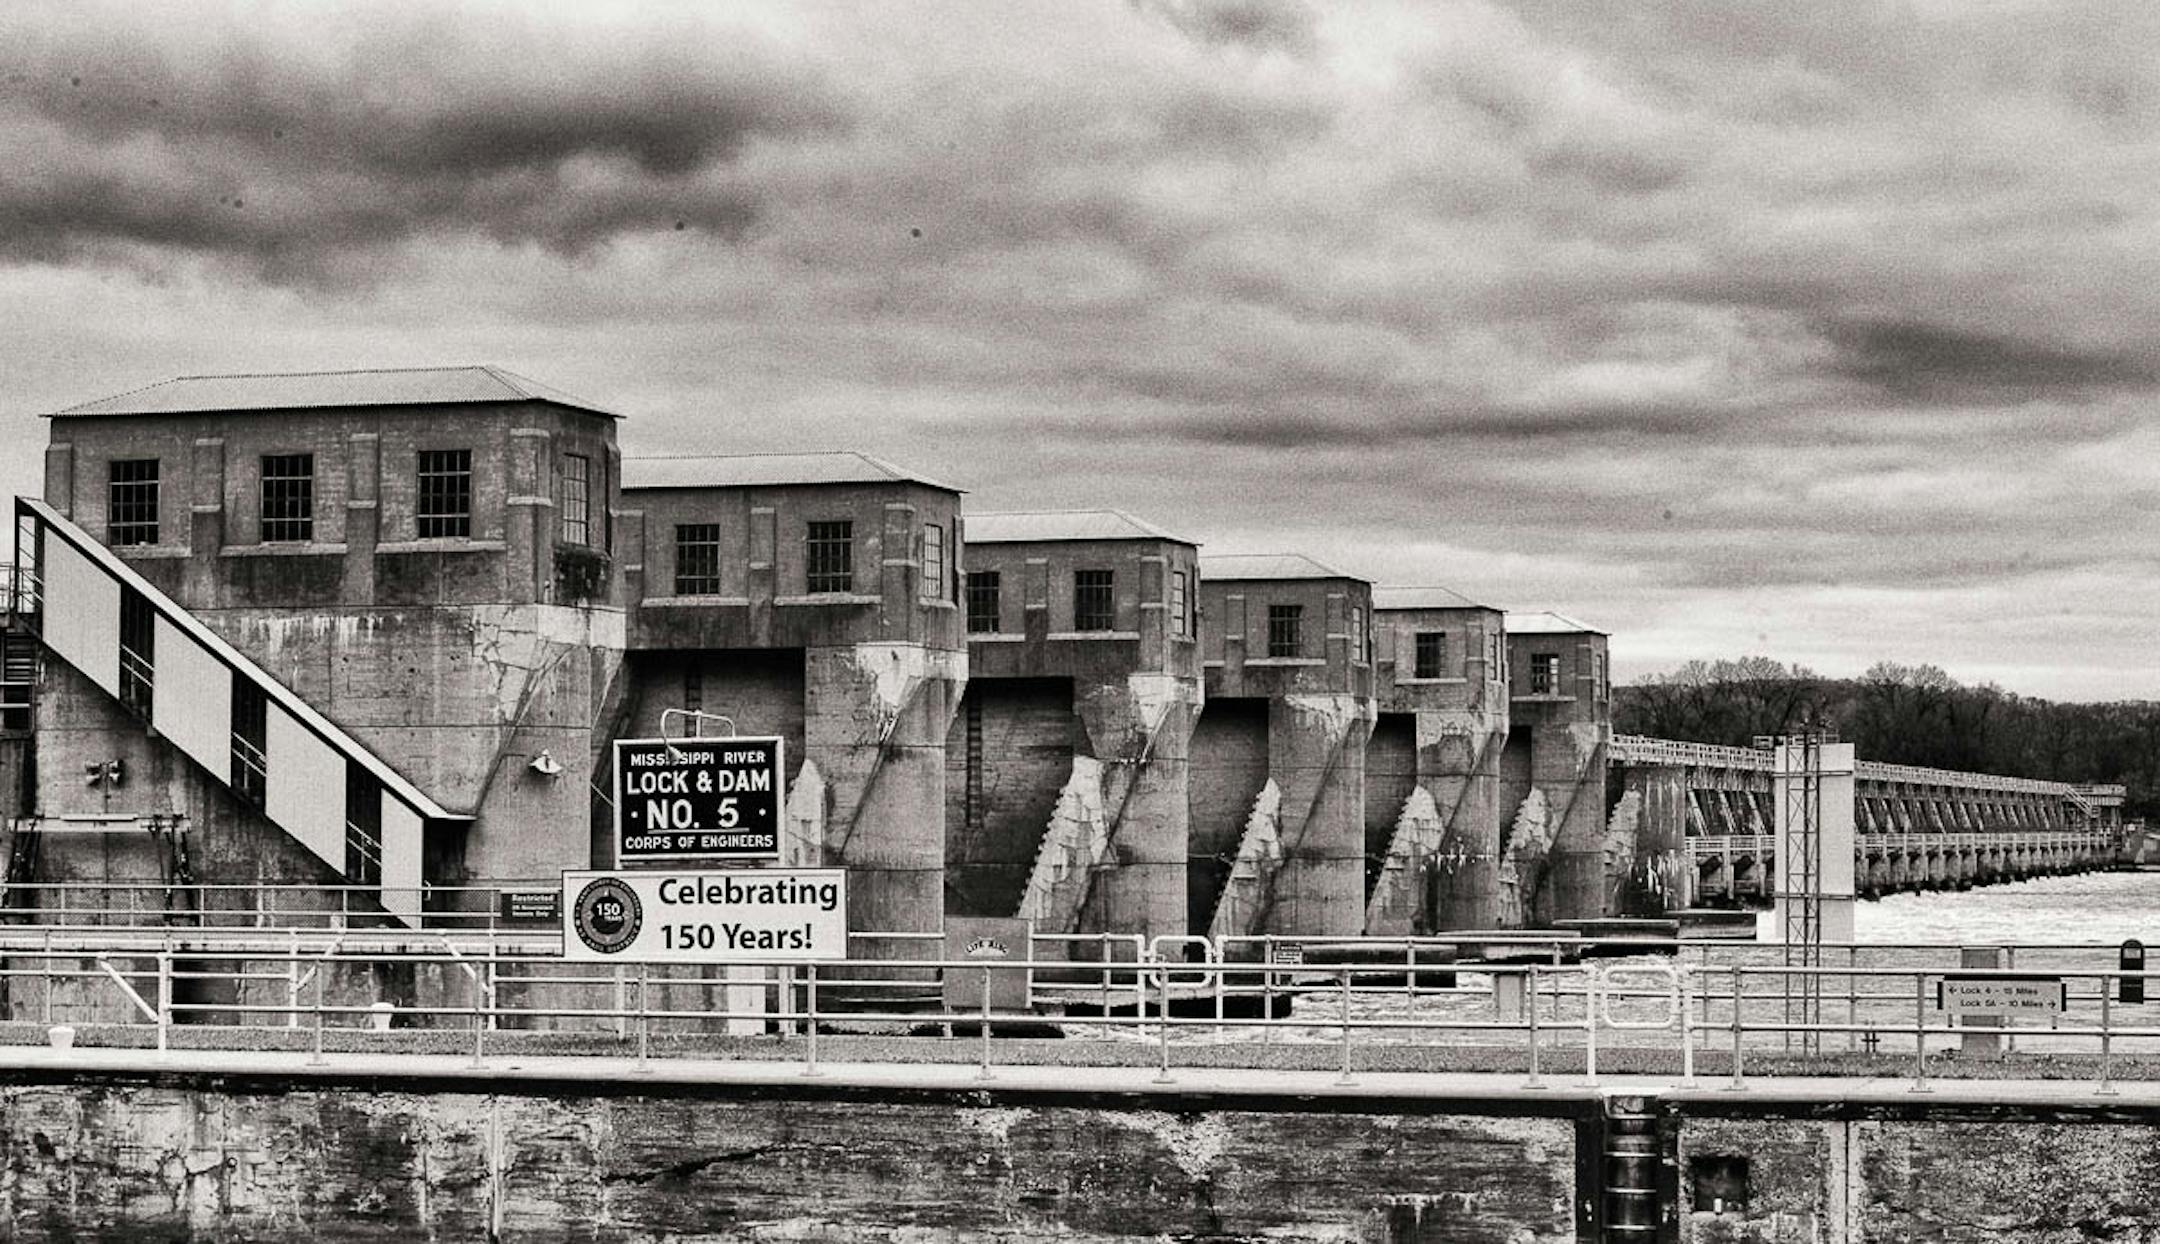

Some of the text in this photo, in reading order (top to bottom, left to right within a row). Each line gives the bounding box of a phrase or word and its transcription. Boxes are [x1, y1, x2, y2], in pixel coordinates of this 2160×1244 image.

[630, 750, 766, 767] MISSSIPPI RIVER
[627, 768, 770, 795] LOCK & DAM
[647, 797, 740, 829] NO. 5
[625, 834, 774, 850] CORPS OF ENGINEERS
[659, 877, 838, 911] Celebrating
[596, 903, 620, 916] 150
[661, 923, 715, 949] 150
[722, 923, 813, 949] Years!
[1960, 986, 1981, 994] Lock
[2016, 987, 2038, 995] Miles
[1960, 999, 1981, 1007] Lock
